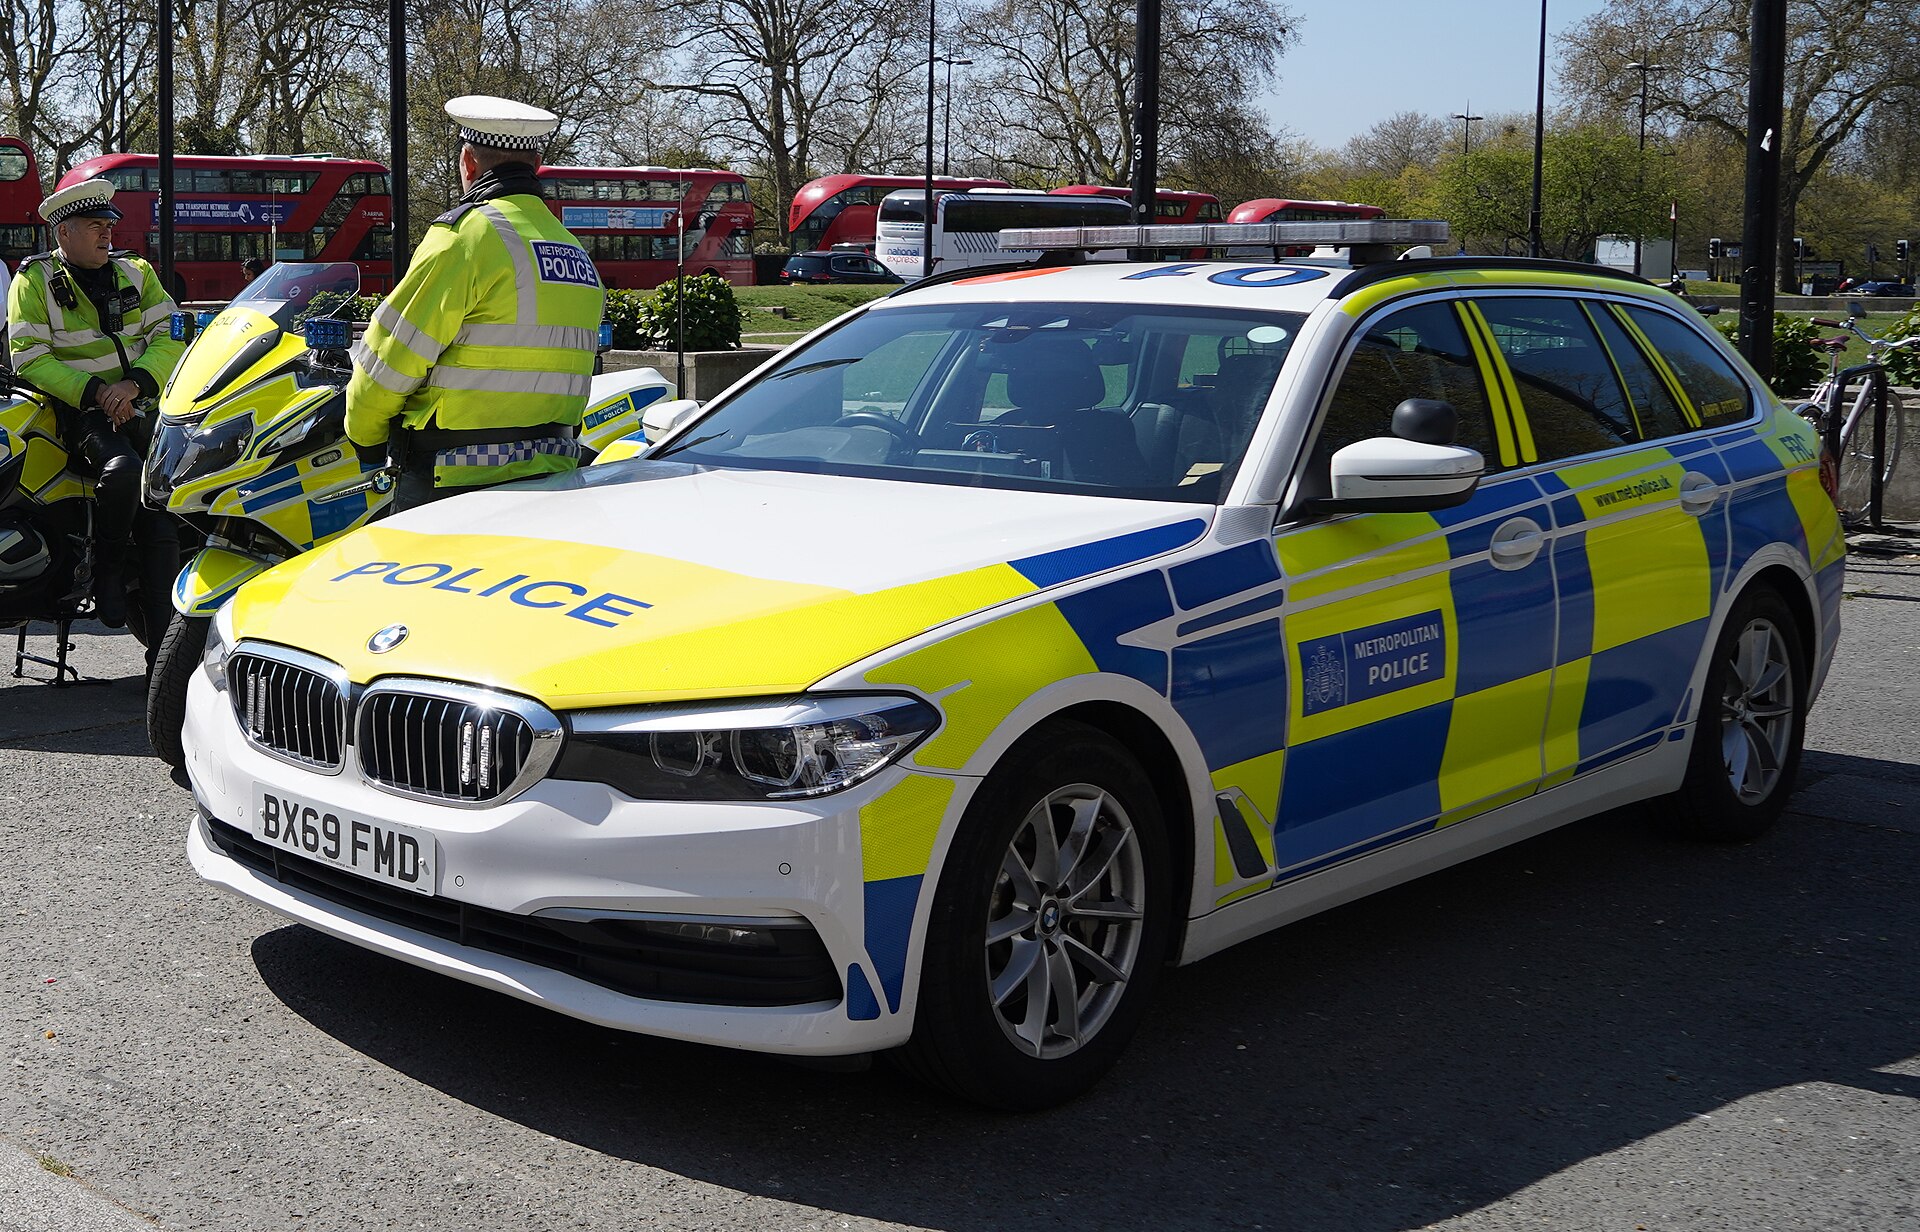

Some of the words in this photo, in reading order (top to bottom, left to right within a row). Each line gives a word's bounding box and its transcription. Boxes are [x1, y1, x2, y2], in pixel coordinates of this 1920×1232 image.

[886, 255, 919, 264] express
[887, 247, 920, 257] national
[541, 257, 596, 283] POLICE
[603, 407, 625, 420] POLICE
[1779, 433, 1815, 463] FRC
[1593, 474, 1672, 507] www.met.police.uk
[329, 562, 655, 628] POLICE
[1353, 623, 1439, 659] METROPOLITAN
[1368, 652, 1429, 685] POLICE
[264, 793, 340, 860] BX69
[351, 820, 419, 883] FMD
